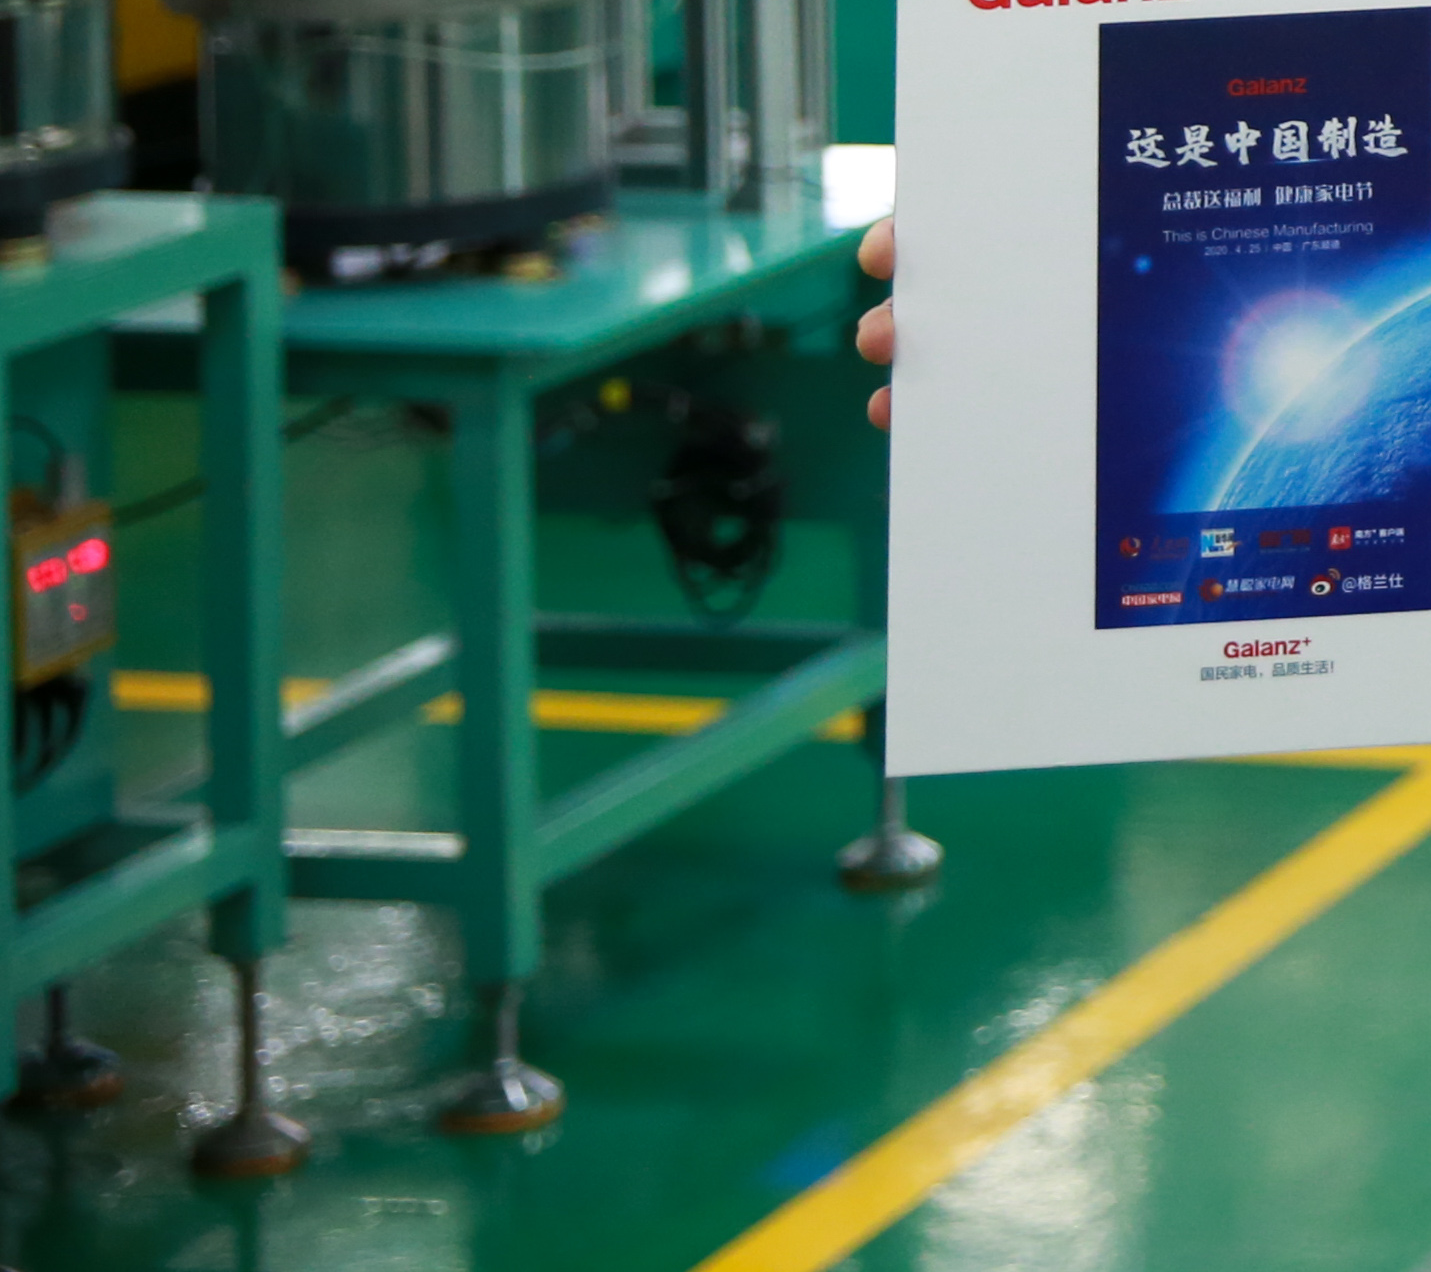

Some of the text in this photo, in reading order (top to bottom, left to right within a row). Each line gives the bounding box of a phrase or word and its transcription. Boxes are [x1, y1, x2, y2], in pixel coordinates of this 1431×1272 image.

[1227, 77, 1308, 97] Galanz
[1125, 113, 1409, 169] 这是中国制造
[1162, 181, 1374, 211] 总裁送福利 健康家电节
[1162, 221, 1374, 243] This is Chinese Manufacturing
[1341, 573, 1404, 594] @格兰仕
